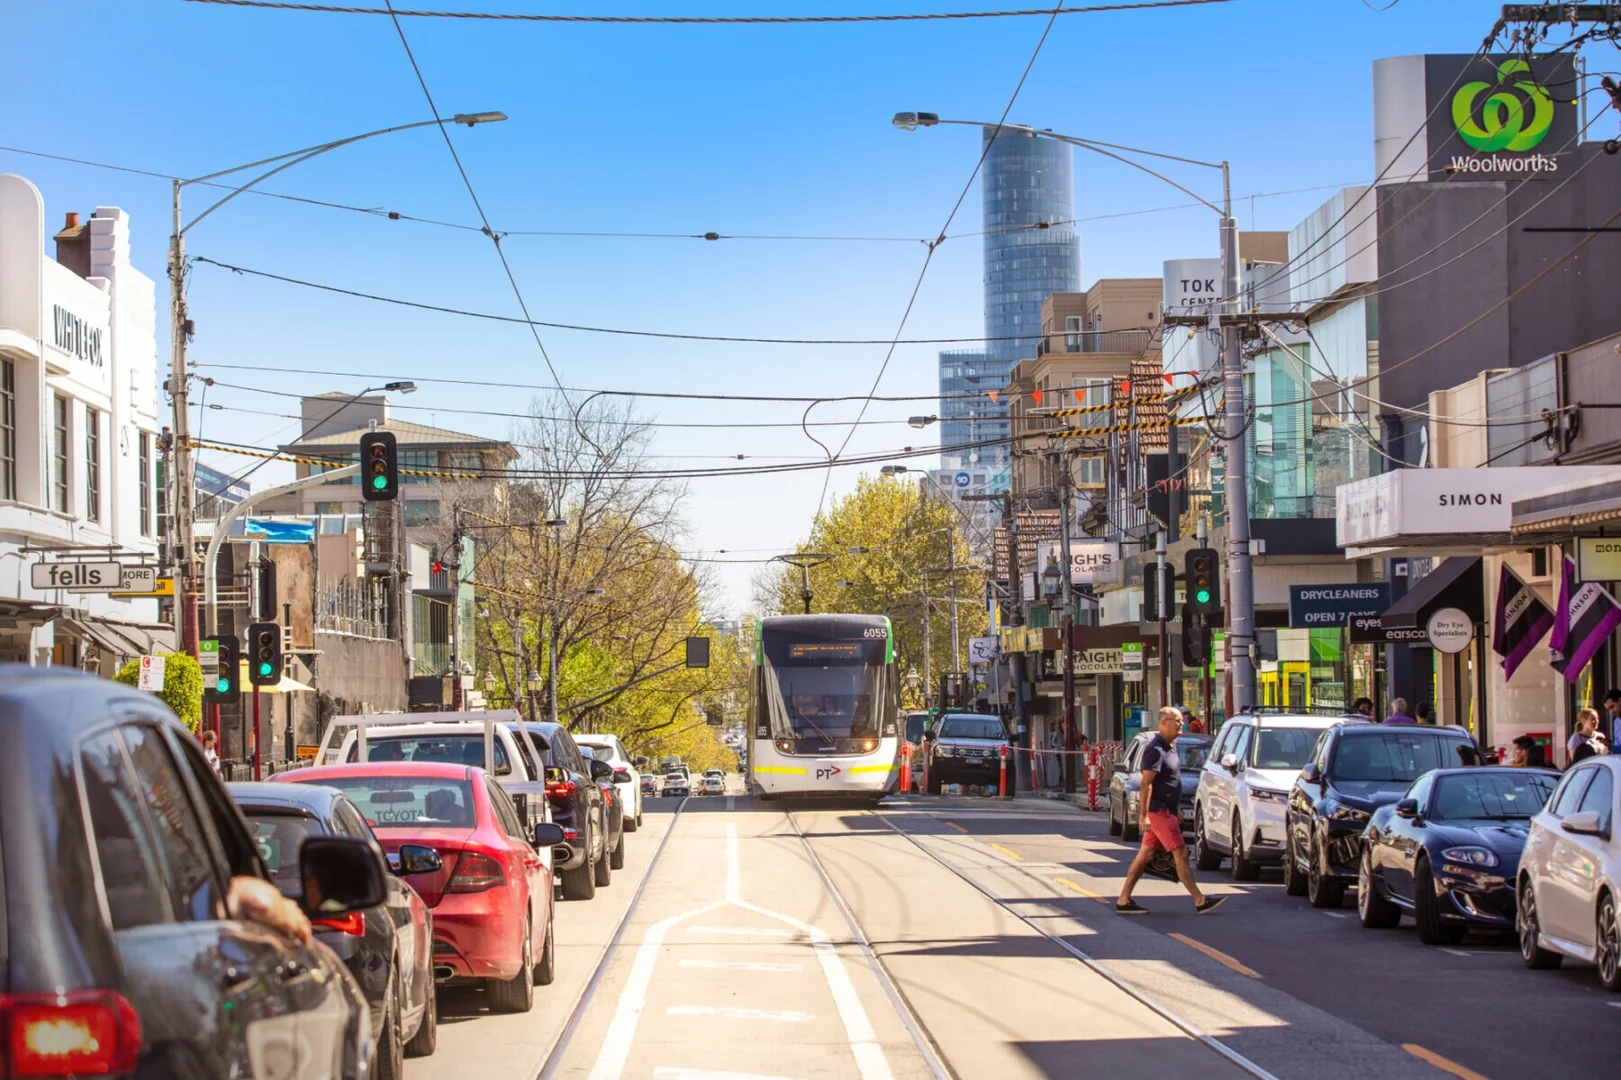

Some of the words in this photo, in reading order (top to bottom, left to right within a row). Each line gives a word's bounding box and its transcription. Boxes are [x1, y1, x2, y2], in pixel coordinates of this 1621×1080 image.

[1451, 154, 1557, 172] Woolworths
[1181, 279, 1214, 292] TOK
[1439, 493, 1502, 506] SIMON
[1595, 544, 1621, 552] mon
[1070, 554, 1111, 565] IGH'S
[48, 564, 101, 585] fells
[123, 571, 150, 579] MORE
[1300, 589, 1379, 600] DRYCLEANERS
[1304, 612, 1335, 622] OPEN
[1338, 612, 1345, 621] 7
[1452, 621, 1464, 629] Eye
[863, 628, 887, 638] 6055
[1433, 629, 1468, 638] Specialists
[375, 810, 425, 821] TOYOTA
